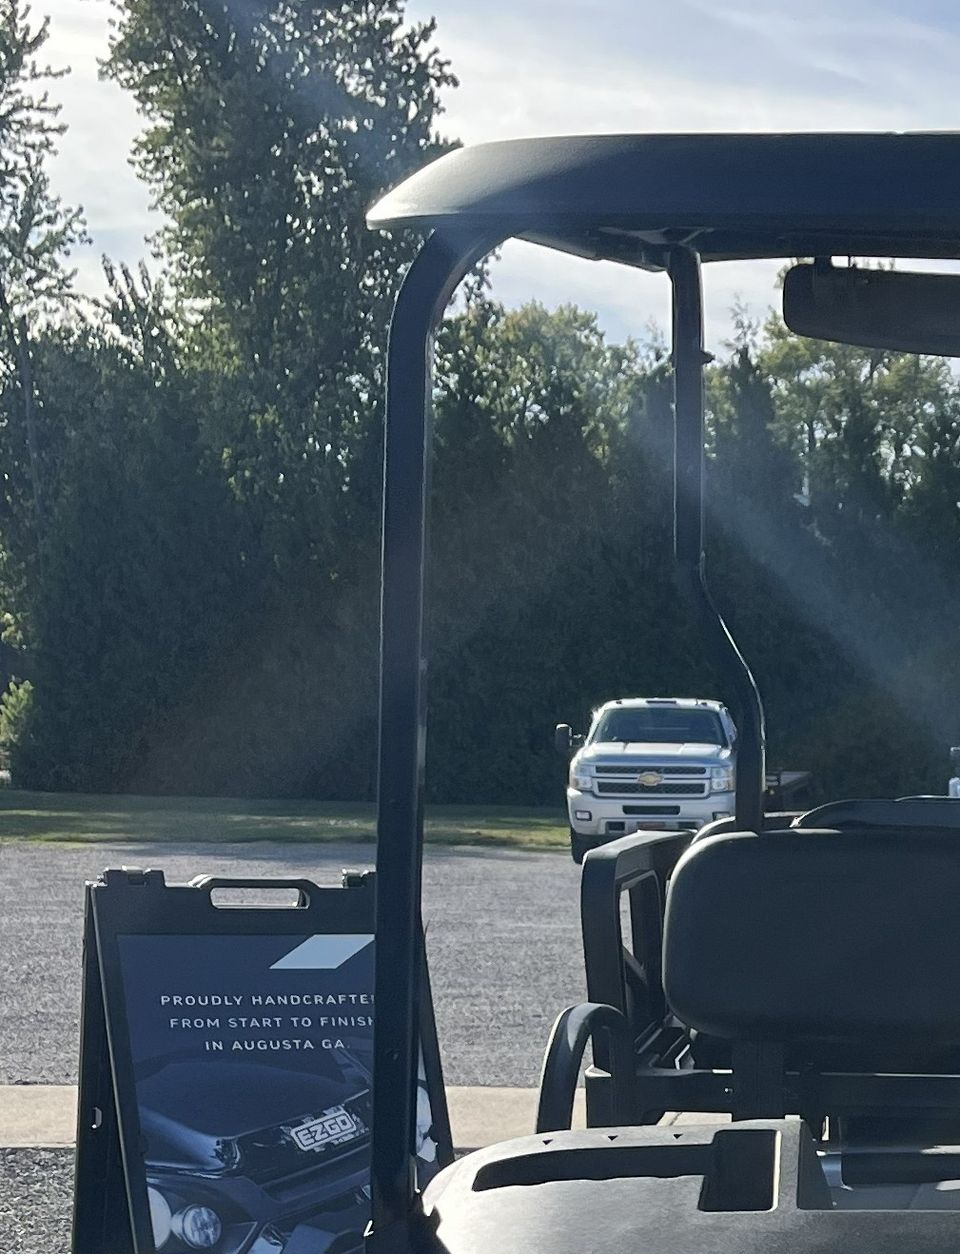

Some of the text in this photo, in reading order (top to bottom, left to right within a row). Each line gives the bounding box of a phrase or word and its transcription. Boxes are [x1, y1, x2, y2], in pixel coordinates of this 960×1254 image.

[160, 994, 243, 1007] PROUDLY
[169, 1017, 220, 1029] FROM
[227, 1016, 282, 1029] START
[290, 1016, 312, 1028] TO
[205, 1040, 224, 1051] IN
[231, 1039, 315, 1051] AUGUSTA
